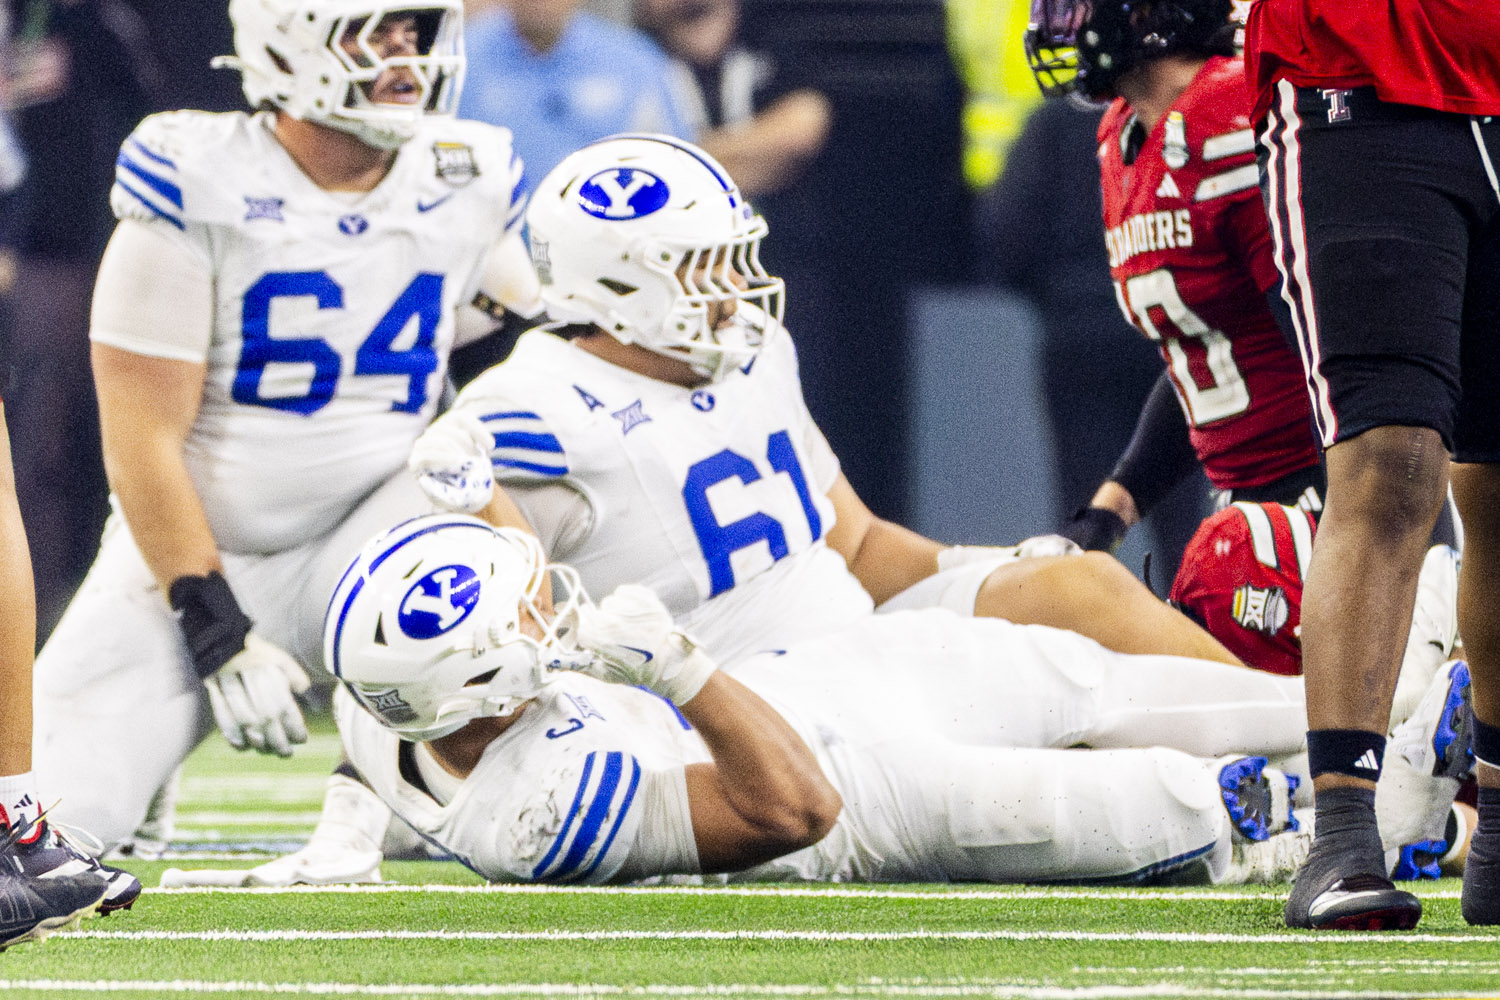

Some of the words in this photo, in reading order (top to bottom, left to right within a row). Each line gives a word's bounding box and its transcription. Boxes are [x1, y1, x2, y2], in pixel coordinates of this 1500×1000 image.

[589, 168, 657, 218] Y
[231, 269, 445, 417] 64
[1114, 268, 1250, 425] 0
[681, 428, 822, 600] 61
